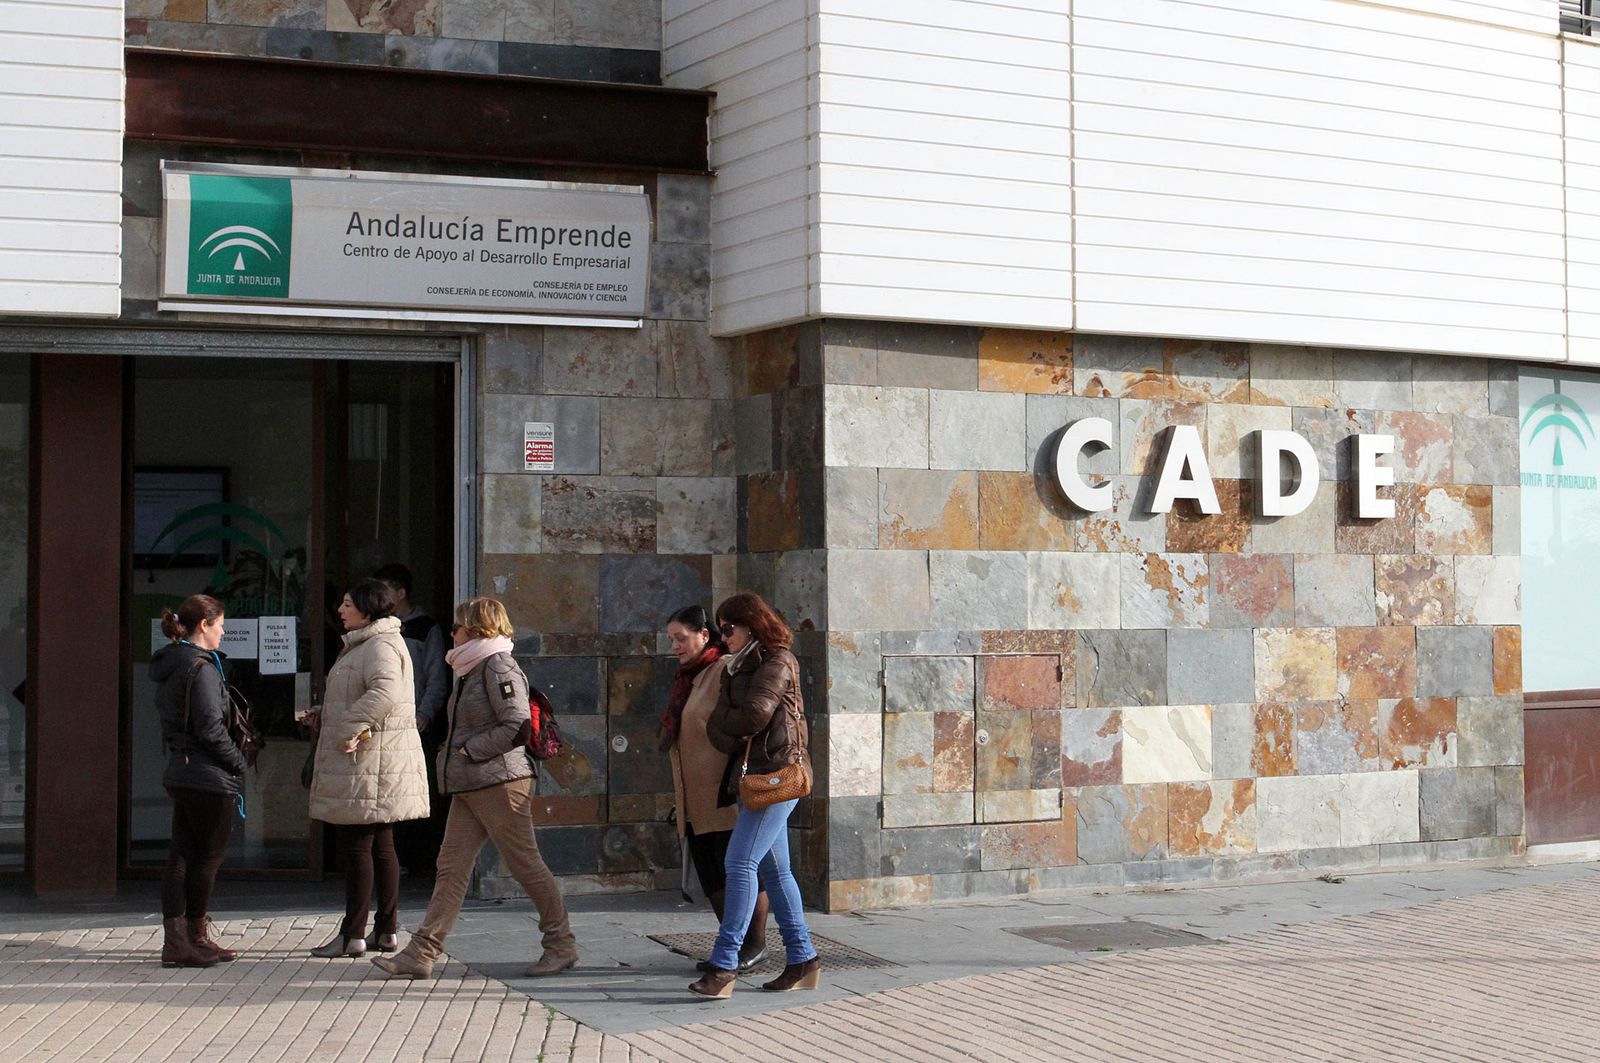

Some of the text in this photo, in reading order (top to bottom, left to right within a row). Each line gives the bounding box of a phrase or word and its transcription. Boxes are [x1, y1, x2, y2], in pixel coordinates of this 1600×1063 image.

[345, 211, 632, 250] Andalucía Emprende
[343, 243, 631, 269] Centro de Apoyo al Desarrollo Empresarial
[196, 274, 222, 283] JUNTA
[225, 275, 235, 284] DE
[533, 280, 582, 290] CONSEJERÍA
[596, 283, 628, 292] EMPLEO
[427, 286, 477, 296] CONSEJERÍA
[538, 291, 587, 300] INNOVACIÓN
[596, 294, 628, 302] CIENCIA
[1055, 416, 1397, 520] CADE
[1545, 474, 1556, 488] DE
